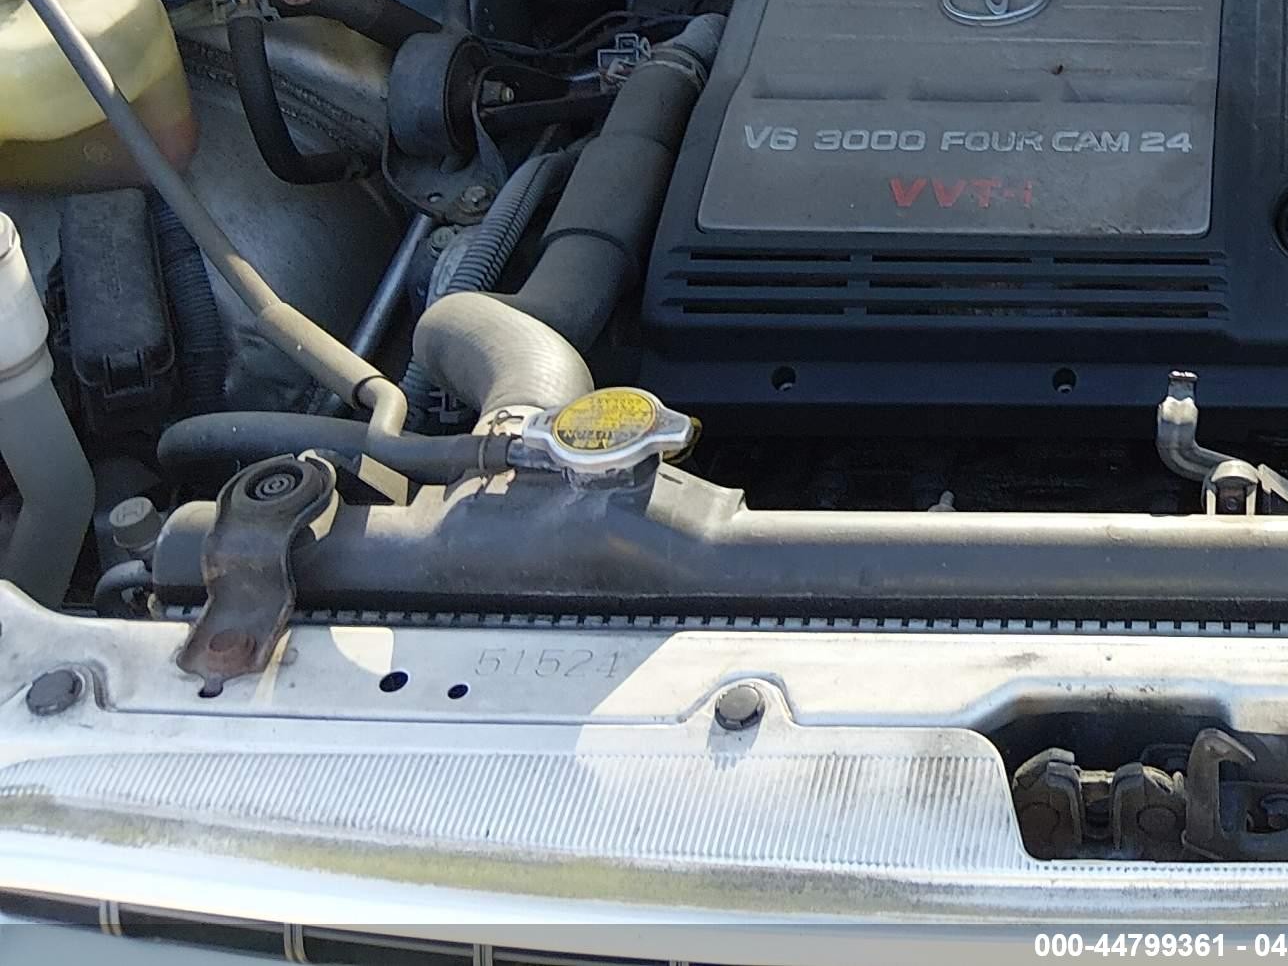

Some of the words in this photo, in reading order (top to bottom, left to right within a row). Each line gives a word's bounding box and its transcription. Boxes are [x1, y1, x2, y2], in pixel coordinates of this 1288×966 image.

[744, 124, 799, 152] V6
[813, 129, 926, 152] 3000
[939, 130, 1043, 153] FOUR
[1051, 130, 1130, 153] CAM
[1139, 131, 1193, 153] 24
